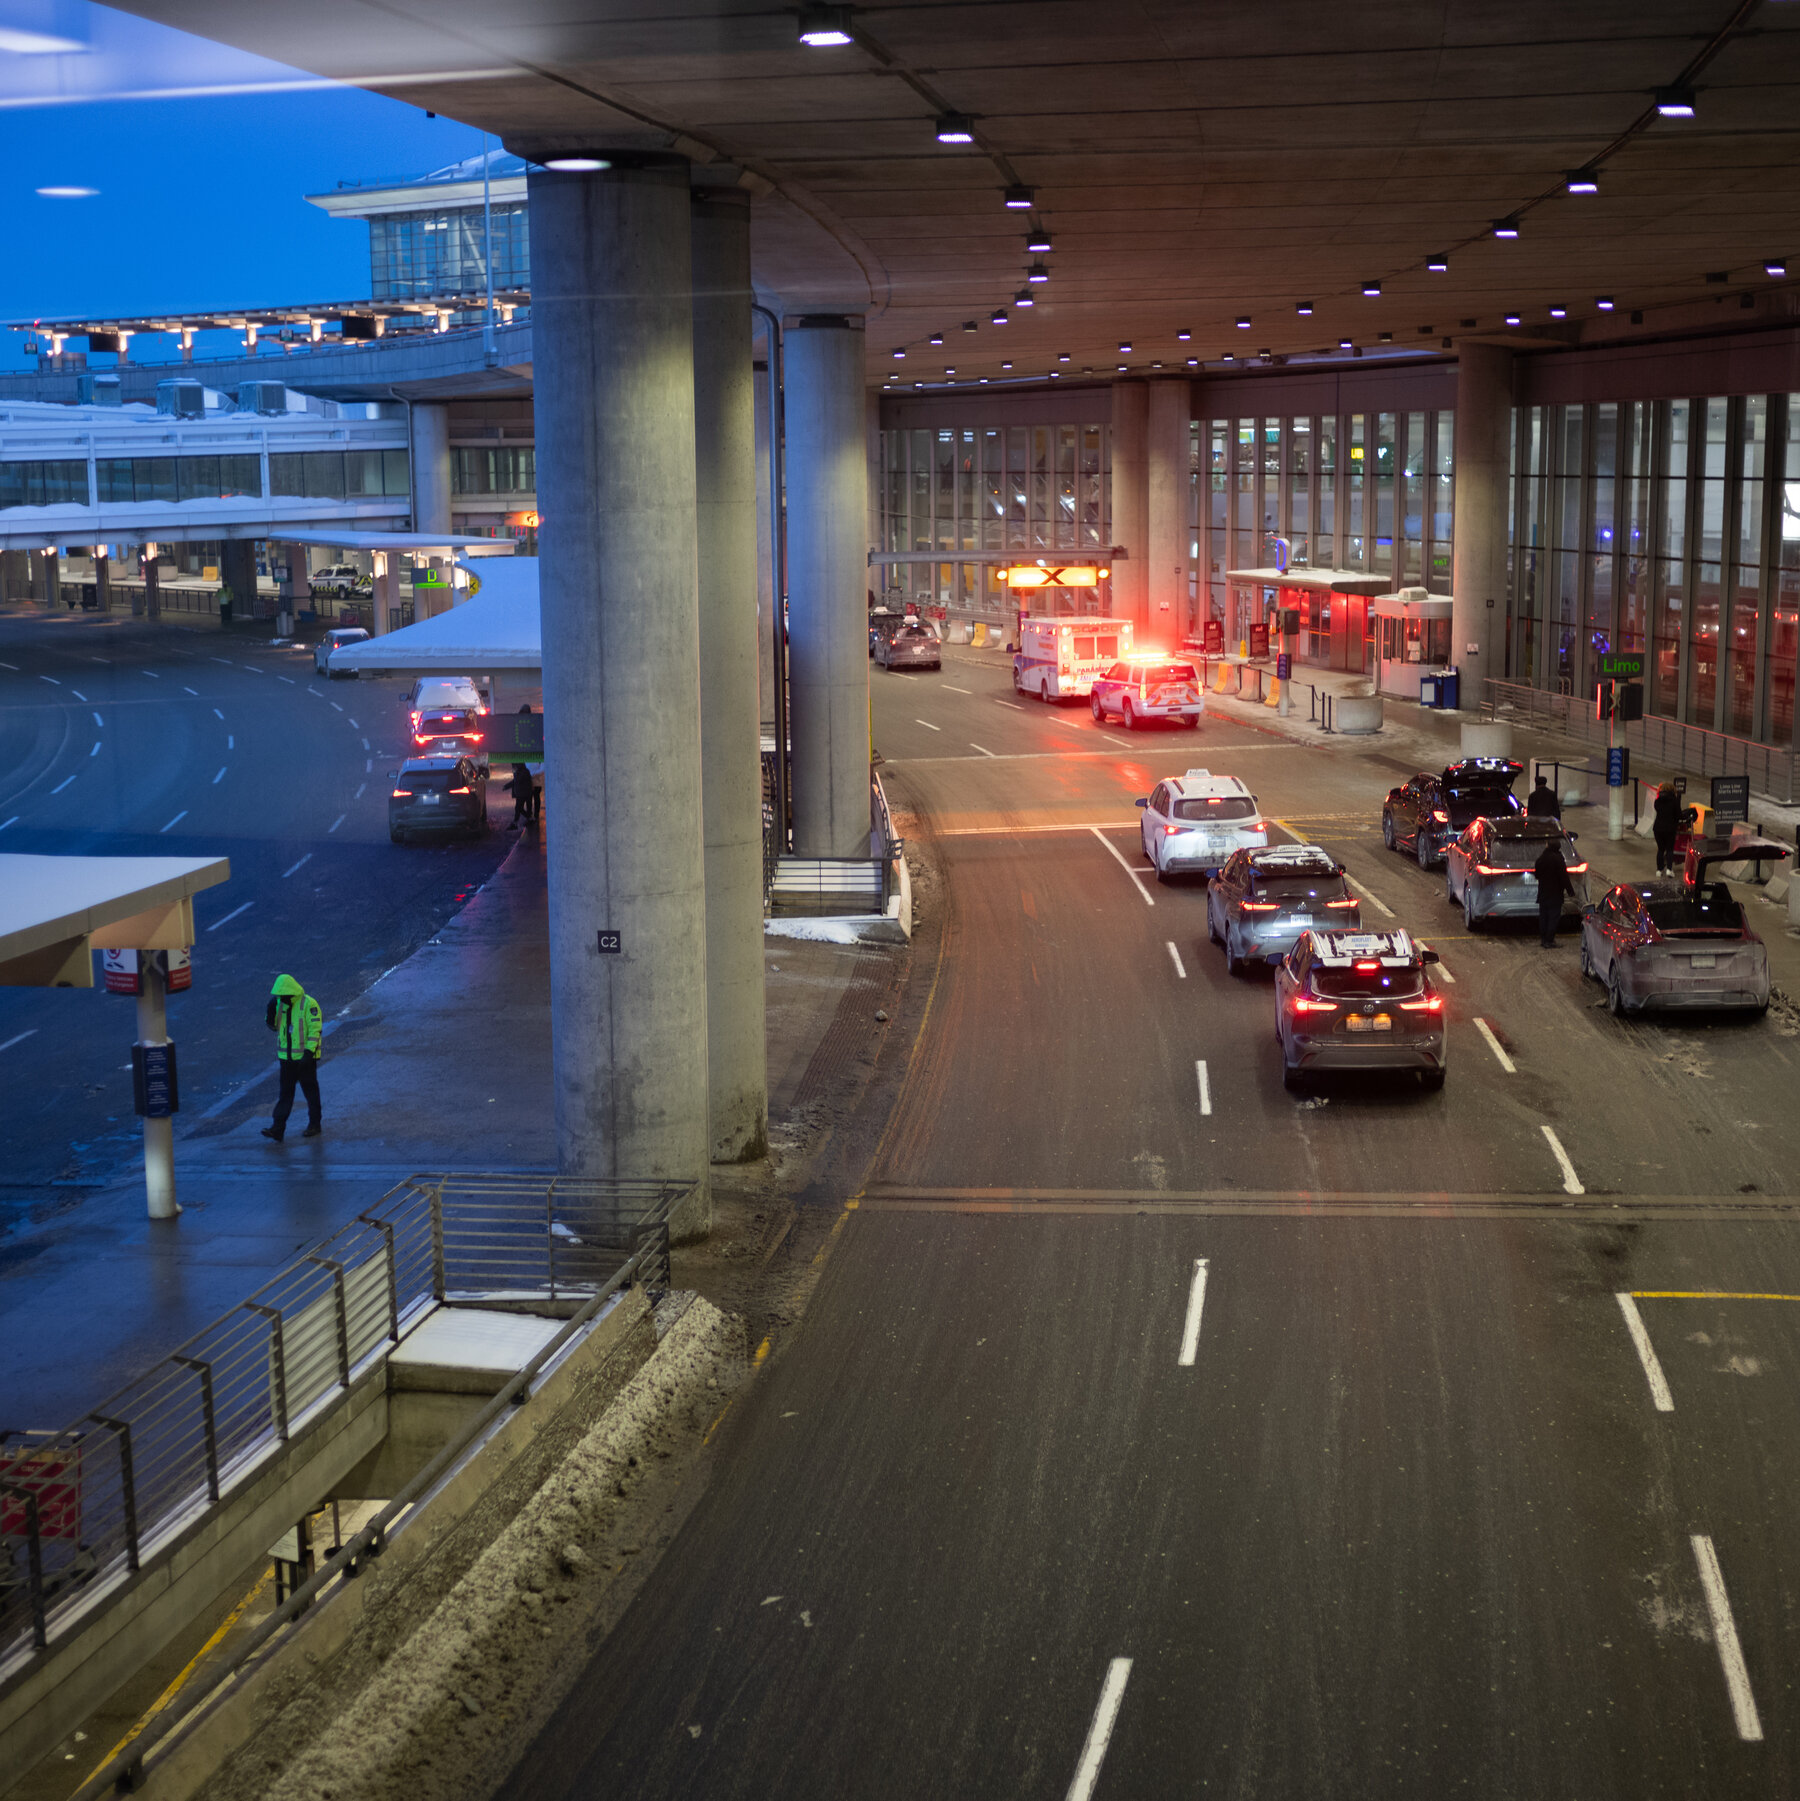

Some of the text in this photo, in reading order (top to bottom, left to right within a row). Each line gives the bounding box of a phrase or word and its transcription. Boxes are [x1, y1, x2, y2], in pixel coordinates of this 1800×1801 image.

[1276, 539, 1287, 571] D
[1604, 658, 1640, 672] Limo
[515, 720, 535, 747] C
[601, 936, 618, 948] C2
